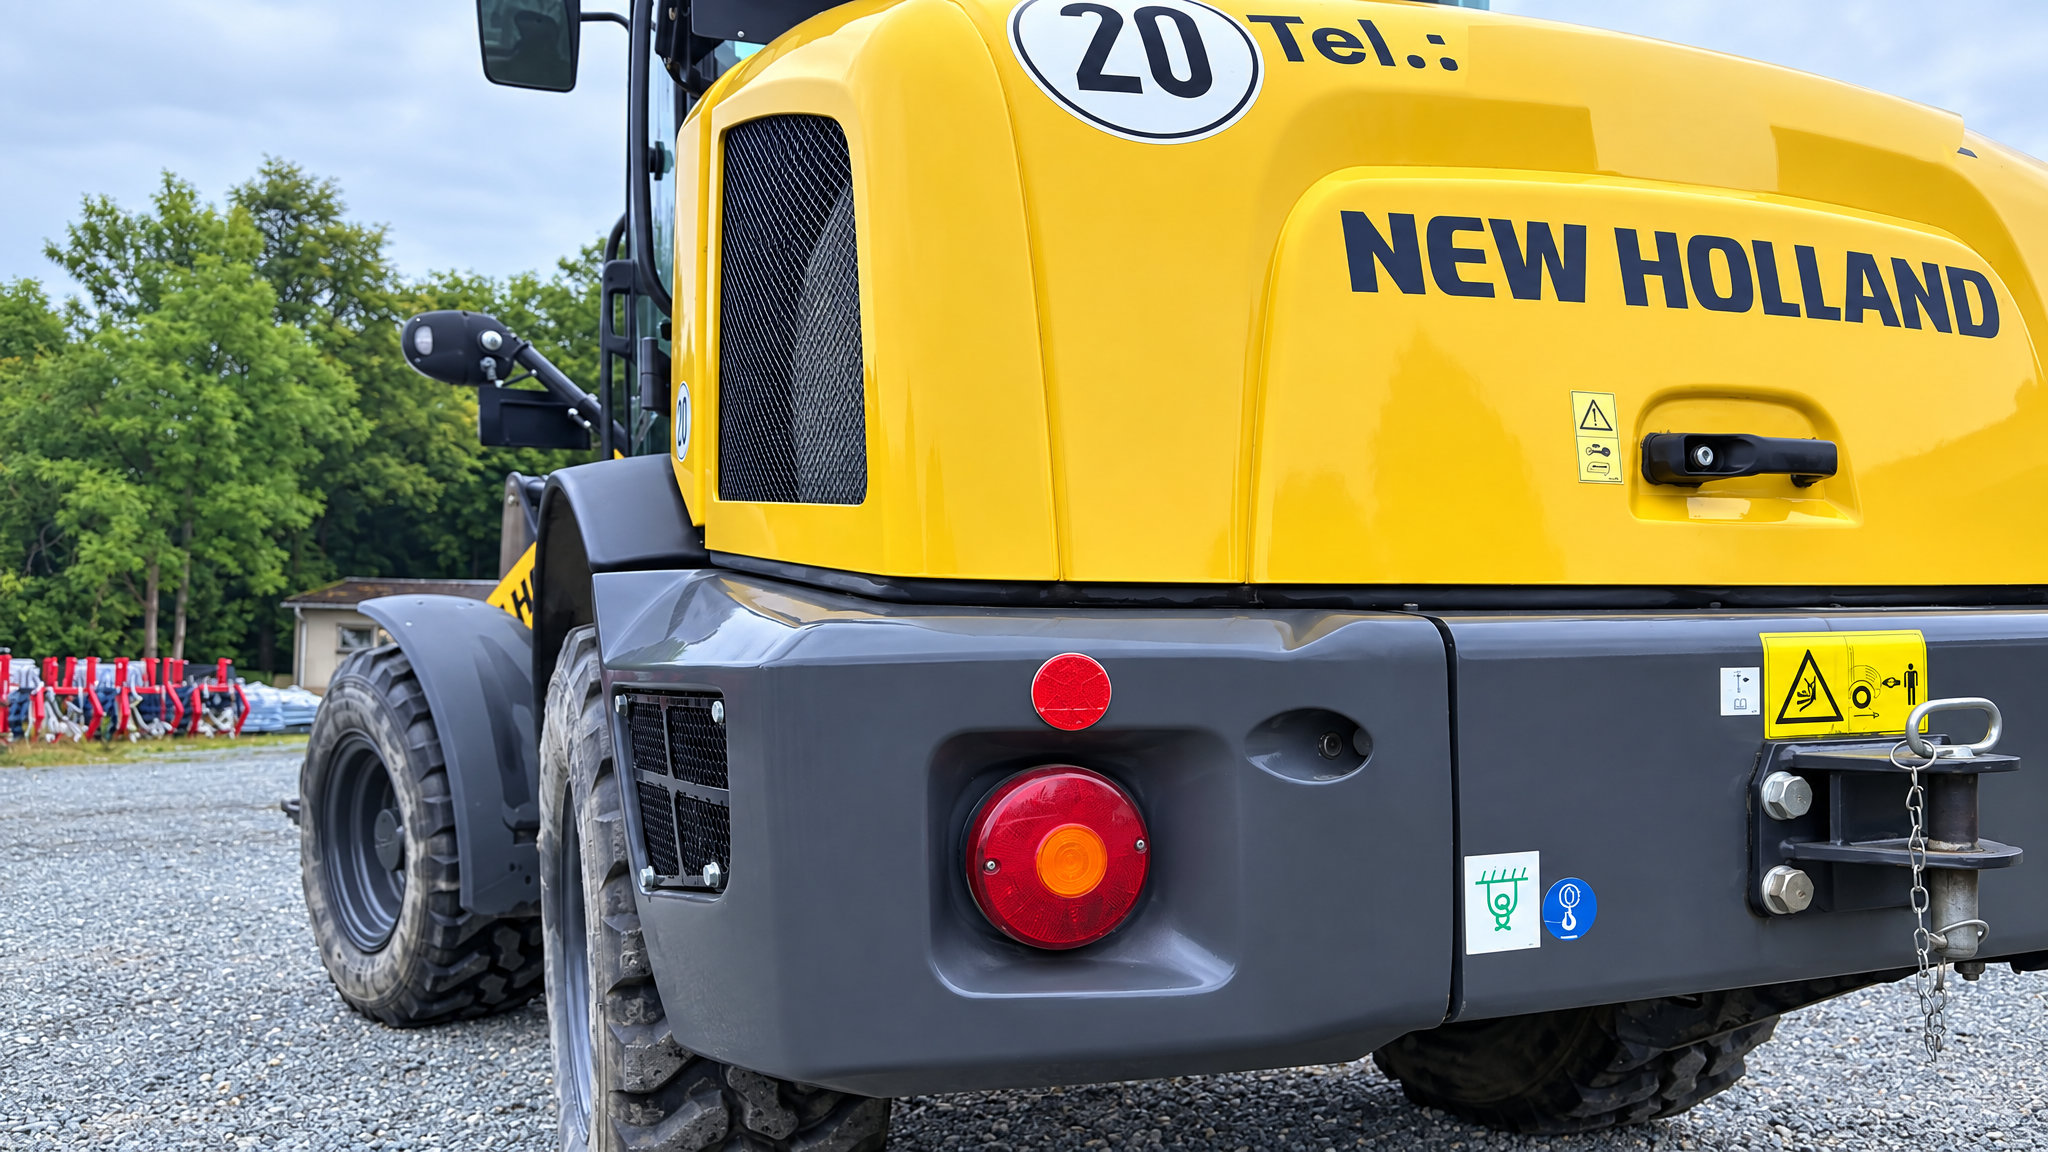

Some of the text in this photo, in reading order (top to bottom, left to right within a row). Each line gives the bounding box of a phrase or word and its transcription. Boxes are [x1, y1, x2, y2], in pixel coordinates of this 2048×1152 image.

[1060, 2, 1213, 98] 20
[1246, 14, 1459, 72] Tel.:
[1340, 210, 2000, 338] NEW HOLLAND
[678, 396, 688, 447] 20
